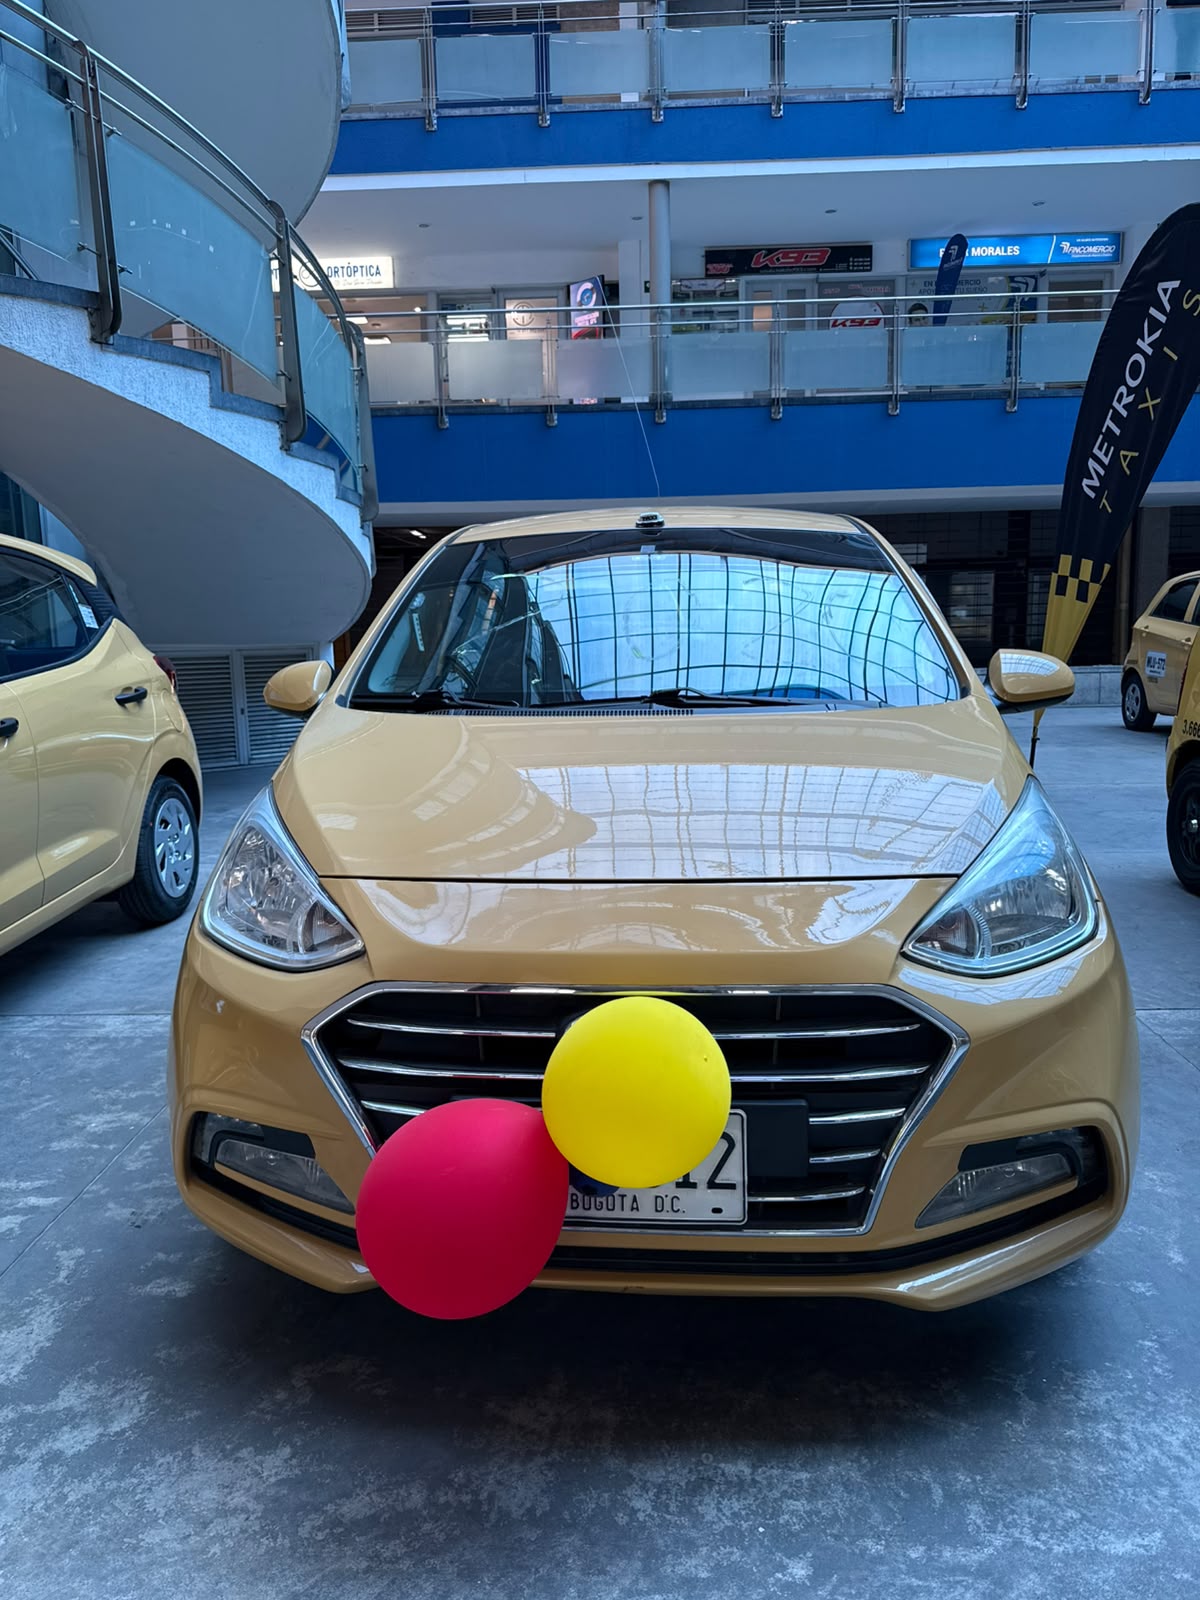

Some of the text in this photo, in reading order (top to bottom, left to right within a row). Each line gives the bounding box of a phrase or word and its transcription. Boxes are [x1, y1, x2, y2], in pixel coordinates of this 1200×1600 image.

[971, 245, 1020, 257] MORALES
[326, 262, 382, 278] ORTÓPTICA
[1081, 280, 1181, 500] METROKIA
